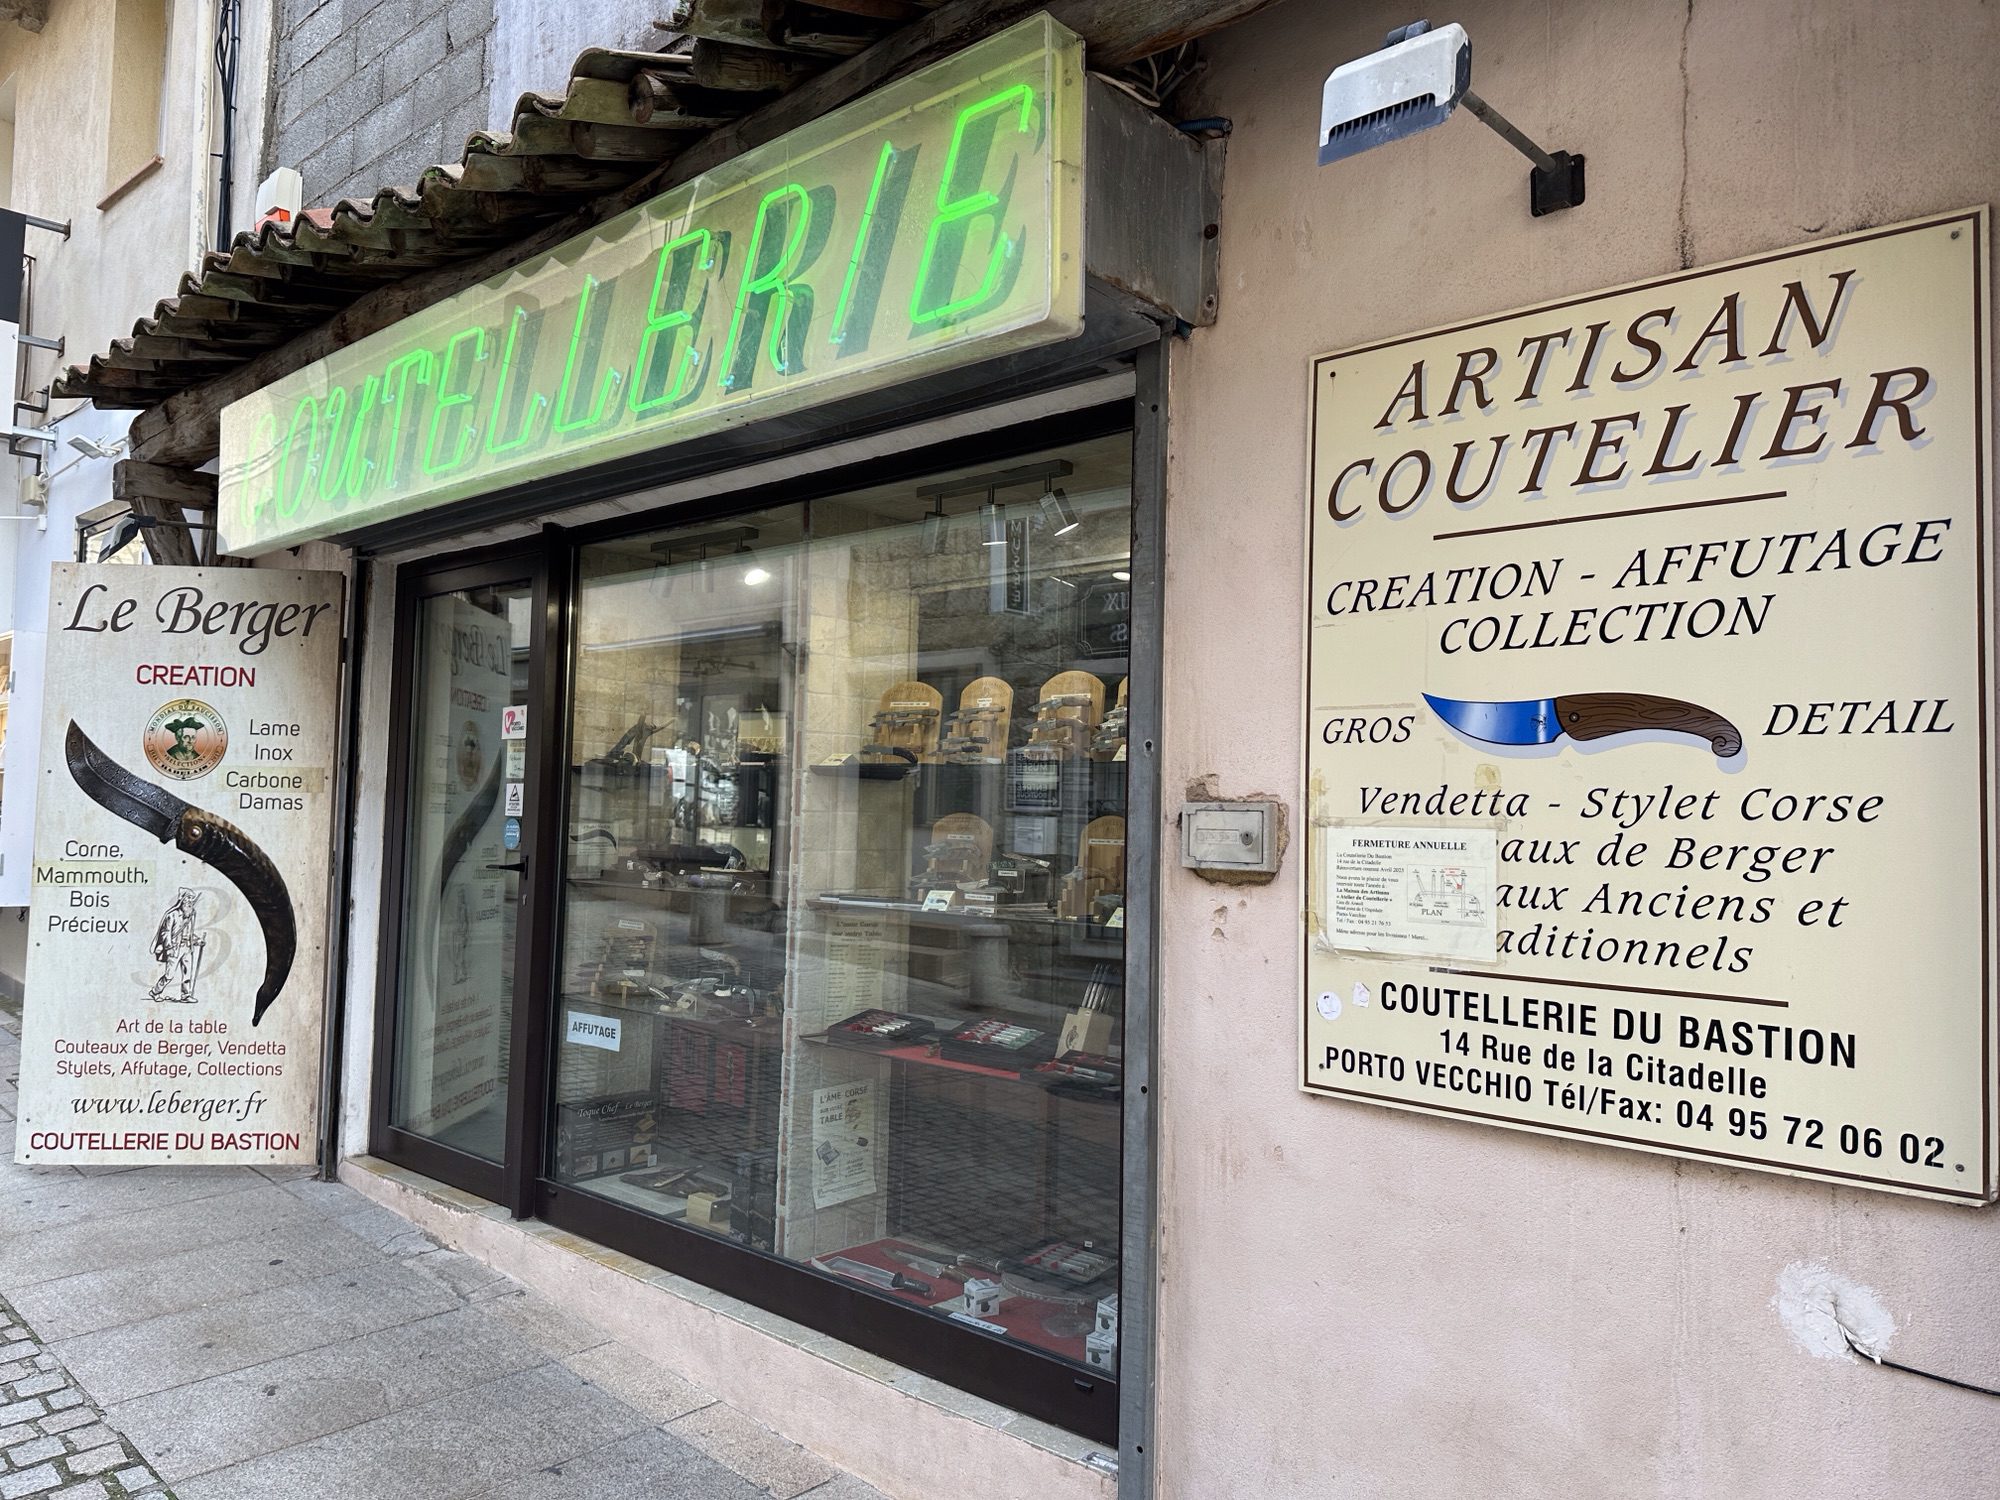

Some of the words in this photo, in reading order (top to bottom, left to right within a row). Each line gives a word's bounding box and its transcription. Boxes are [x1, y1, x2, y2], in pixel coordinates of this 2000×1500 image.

[240, 83, 1040, 528] COUTELLERIE
[1373, 269, 1858, 429] ARTISAN
[1327, 366, 1931, 522] COUTELIER
[1326, 558, 1565, 615] CREATION
[1613, 517, 1952, 588] AFFUTAGE
[63, 584, 138, 633] Le
[156, 586, 331, 655] Berger
[1440, 594, 1776, 654] COLLECTION
[136, 664, 256, 687] CREATION
[249, 719, 300, 736] Lame
[1322, 715, 1415, 745] GROS
[1761, 698, 1956, 737] DETAIL
[254, 744, 293, 761] Inox
[225, 771, 303, 788] Carbone
[239, 792, 304, 810] Damas
[1359, 786, 1531, 817] Vendetta
[1581, 785, 1722, 828] Stylet
[1738, 787, 1884, 824] Corse
[65, 839, 124, 859] Corne,
[1352, 839, 1410, 848] FERMETURE
[1412, 841, 1467, 851] ANNUELLE
[1597, 835, 1648, 869] de
[1669, 837, 1834, 882] Berger
[36, 866, 149, 885] Mammouth,
[69, 890, 110, 908] Bois
[1582, 884, 1772, 926] Anciens
[1797, 897, 1848, 928] et
[48, 915, 129, 933] Précieux
[116, 1019, 140, 1033] Art
[145, 1019, 163, 1034] de
[168, 1019, 183, 1034] la
[189, 1019, 227, 1035] table
[572, 1021, 616, 1040] AFFUTAGE
[1380, 981, 1597, 1038] COUTELLERIE
[1613, 1008, 1661, 1044] DU
[1678, 1017, 1857, 1070] BASTION
[55, 1039, 127, 1055] Couteaux
[133, 1039, 151, 1056] de
[158, 1040, 212, 1058] Berger,
[217, 1041, 286, 1056] Vendetta
[57, 1061, 115, 1078] Stylets,
[121, 1061, 192, 1078] Affutage,
[197, 1061, 282, 1077] Collections
[1440, 1029, 1471, 1057] 14
[1482, 1034, 1533, 1066] Rue
[1543, 1041, 1575, 1071] de
[1587, 1047, 1612, 1078] la
[1626, 1052, 1767, 1099] Citadelle
[71, 1090, 267, 1121] www.leberger.fr
[1326, 1047, 1405, 1083] PORTO
[1416, 1062, 1533, 1103] VECCHIO
[1543, 1079, 1663, 1125] Tél/Fax:
[1676, 1099, 1714, 1132] 04
[1728, 1107, 1769, 1141] 95
[1783, 1116, 1824, 1150] 72
[1840, 1124, 1883, 1160] 06
[1900, 1134, 1946, 1168] 02
[30, 1132, 168, 1150] COUTELLERIE
[175, 1133, 203, 1150] DU
[210, 1133, 299, 1151] BASTION
